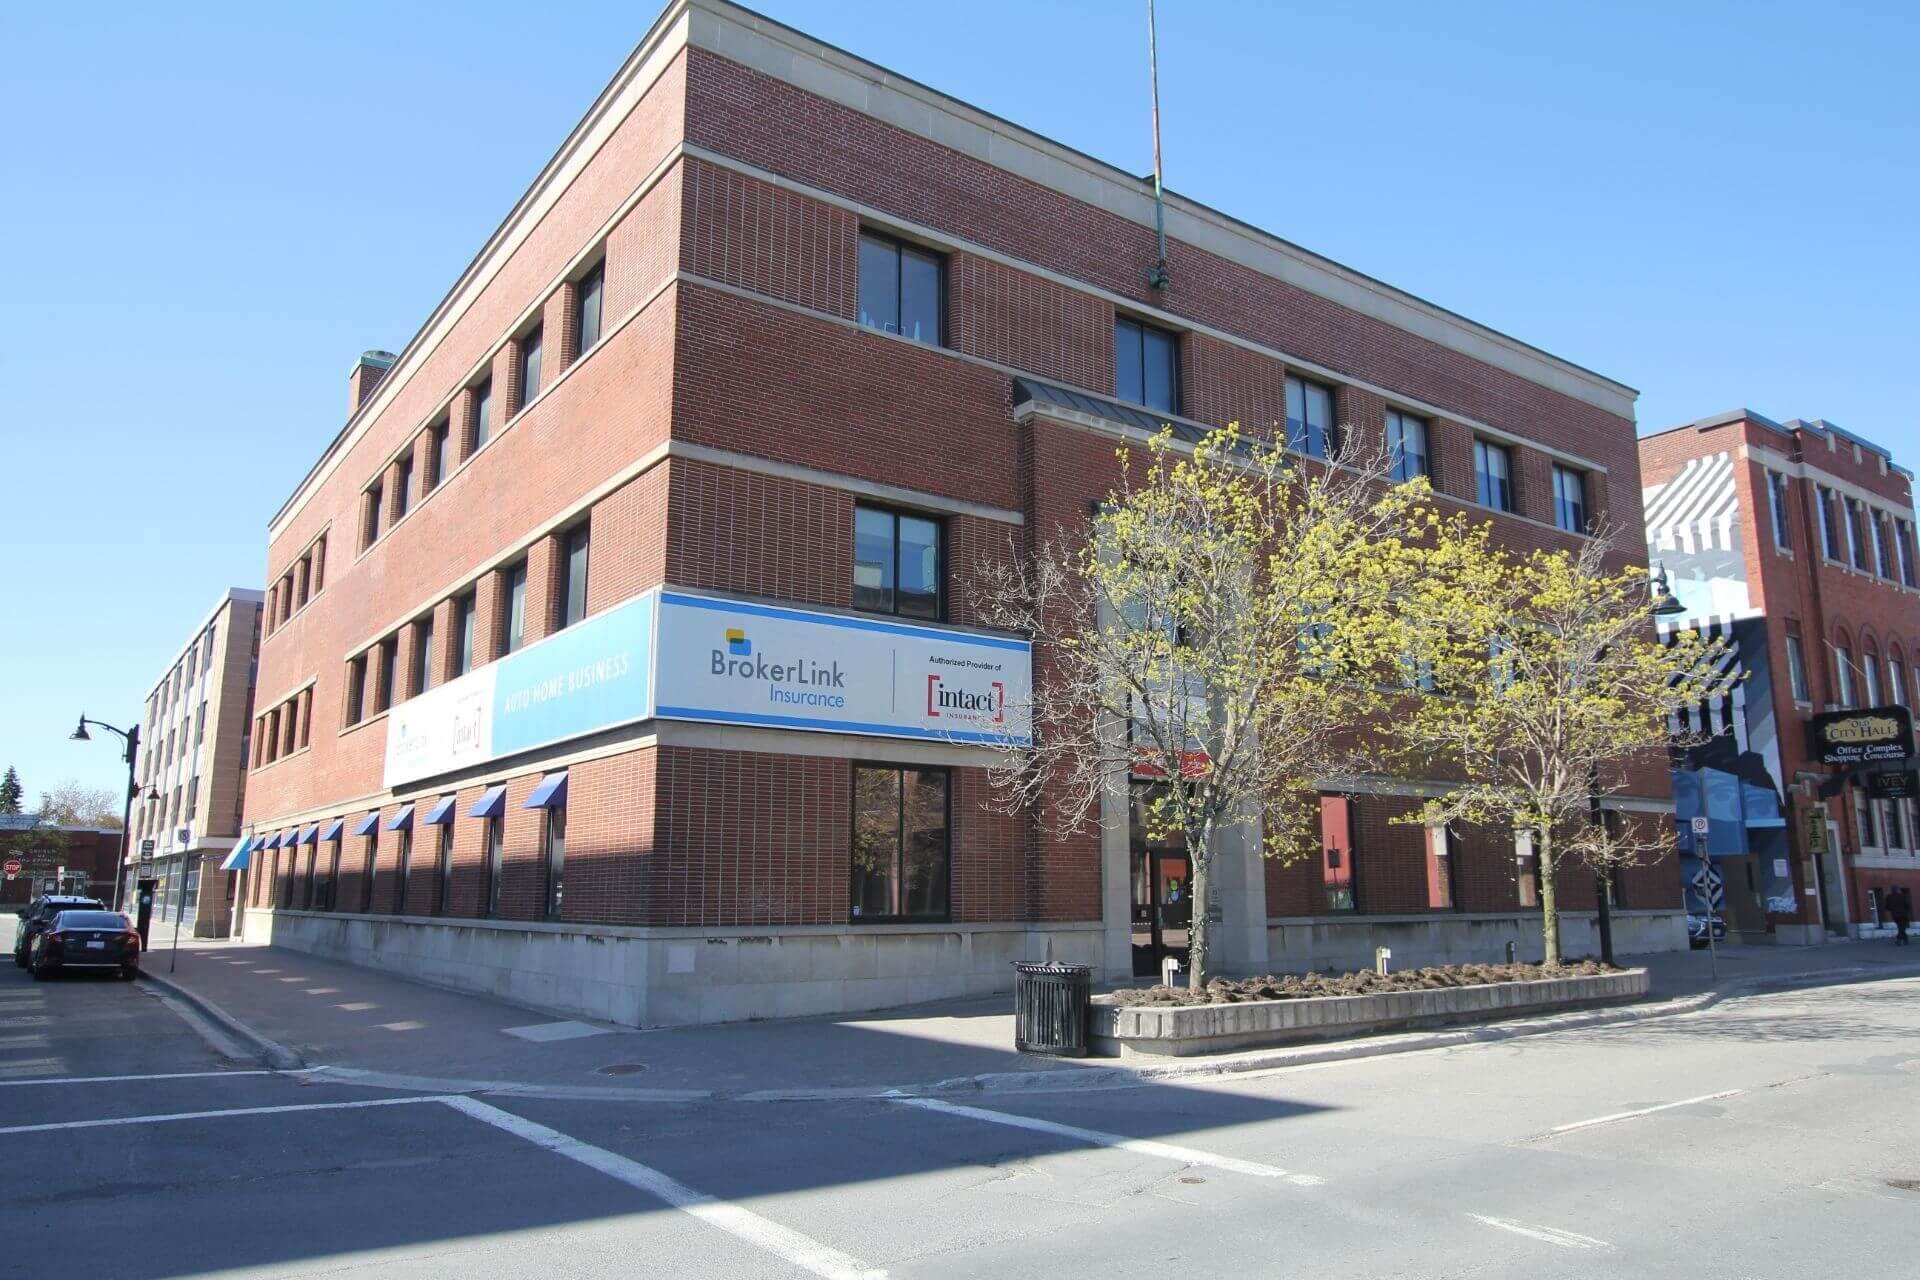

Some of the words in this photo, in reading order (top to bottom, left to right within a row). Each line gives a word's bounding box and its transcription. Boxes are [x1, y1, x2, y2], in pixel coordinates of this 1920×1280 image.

[711, 649, 845, 688] BrokerLink
[929, 656, 966, 667] Authorized
[966, 660, 993, 671] Provider
[994, 664, 1002, 672] of
[504, 687, 530, 713] AUTO
[532, 674, 563, 703] HOME
[568, 653, 630, 690] BUSINESS
[770, 683, 845, 708] Insurance
[1830, 728, 1858, 740] CITY
[1860, 726, 1896, 738] HALL
[1824, 754, 1861, 764] Shopping
[1863, 751, 1905, 760] Concourse
[1837, 746, 1863, 756] Office
[1866, 744, 1904, 754] Complex
[6, 863, 20, 871] STOP
